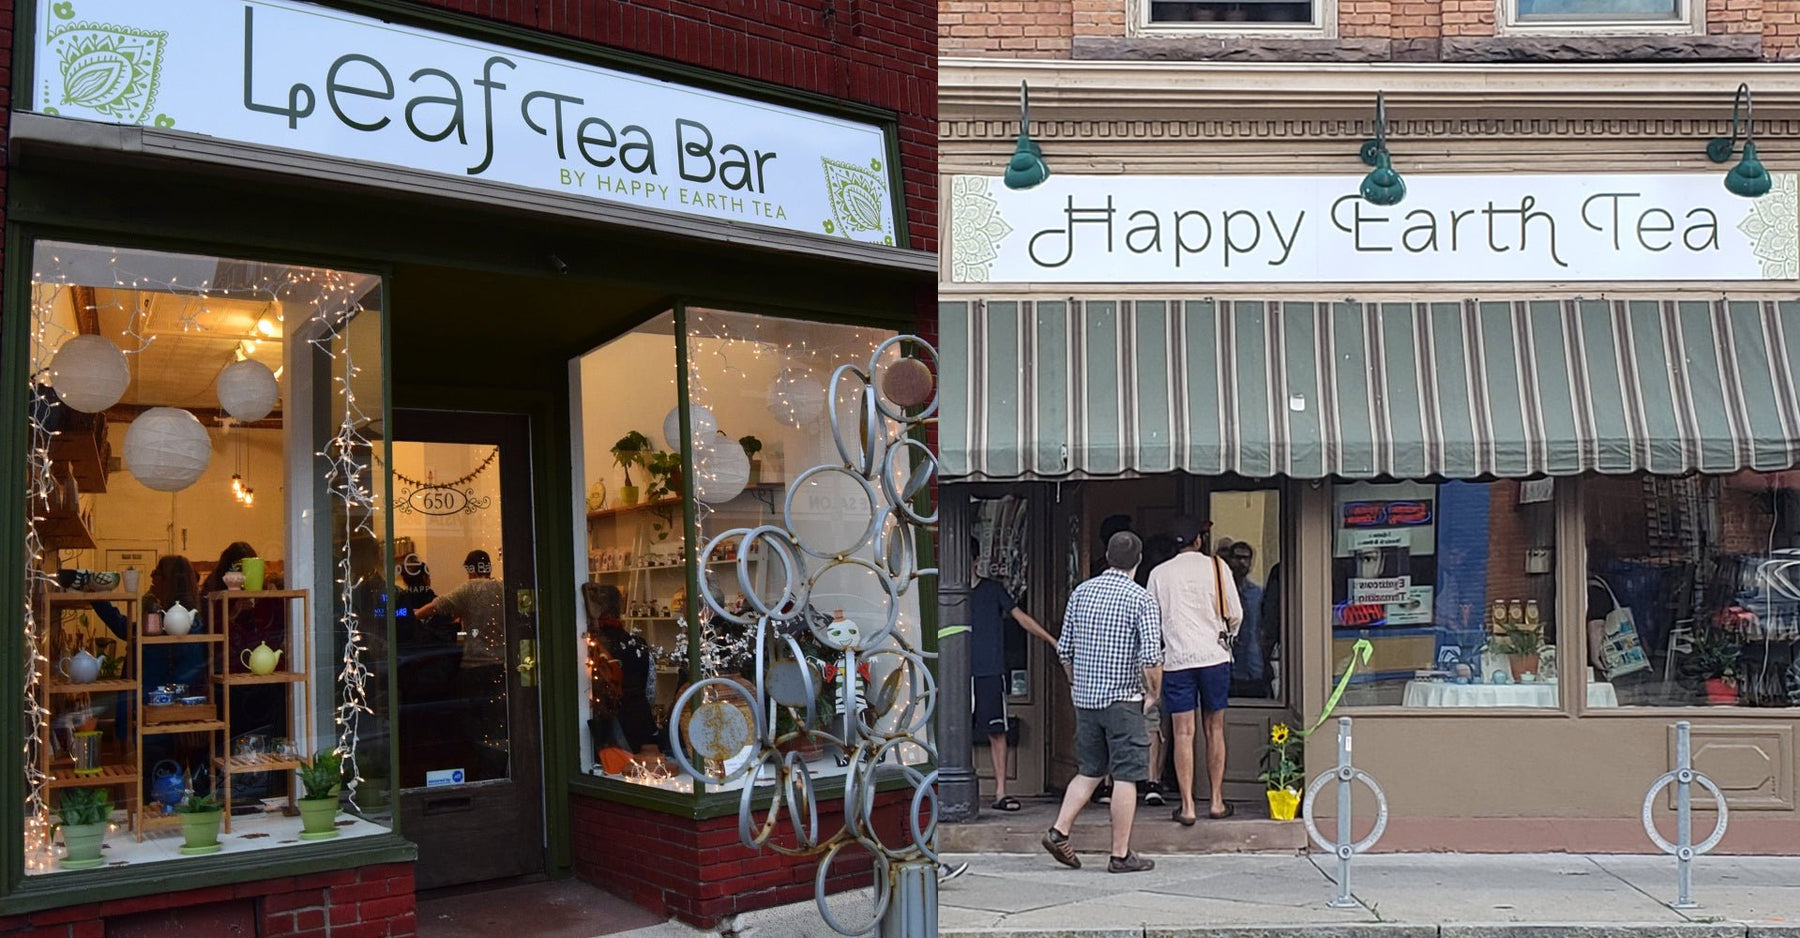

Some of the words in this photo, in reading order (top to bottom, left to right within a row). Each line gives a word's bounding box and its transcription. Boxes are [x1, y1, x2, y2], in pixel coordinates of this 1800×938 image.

[243, 5, 518, 175] Leaf
[521, 90, 659, 176] Tea
[675, 118, 778, 194] Bar
[559, 167, 586, 188] BY
[596, 173, 670, 203] HAPPY
[679, 187, 746, 214] EARTH
[751, 198, 788, 222] TEA
[1029, 194, 1306, 268] Happy
[1332, 194, 1569, 268] Earth
[1582, 192, 1721, 252] Tea
[423, 491, 455, 510] 650
